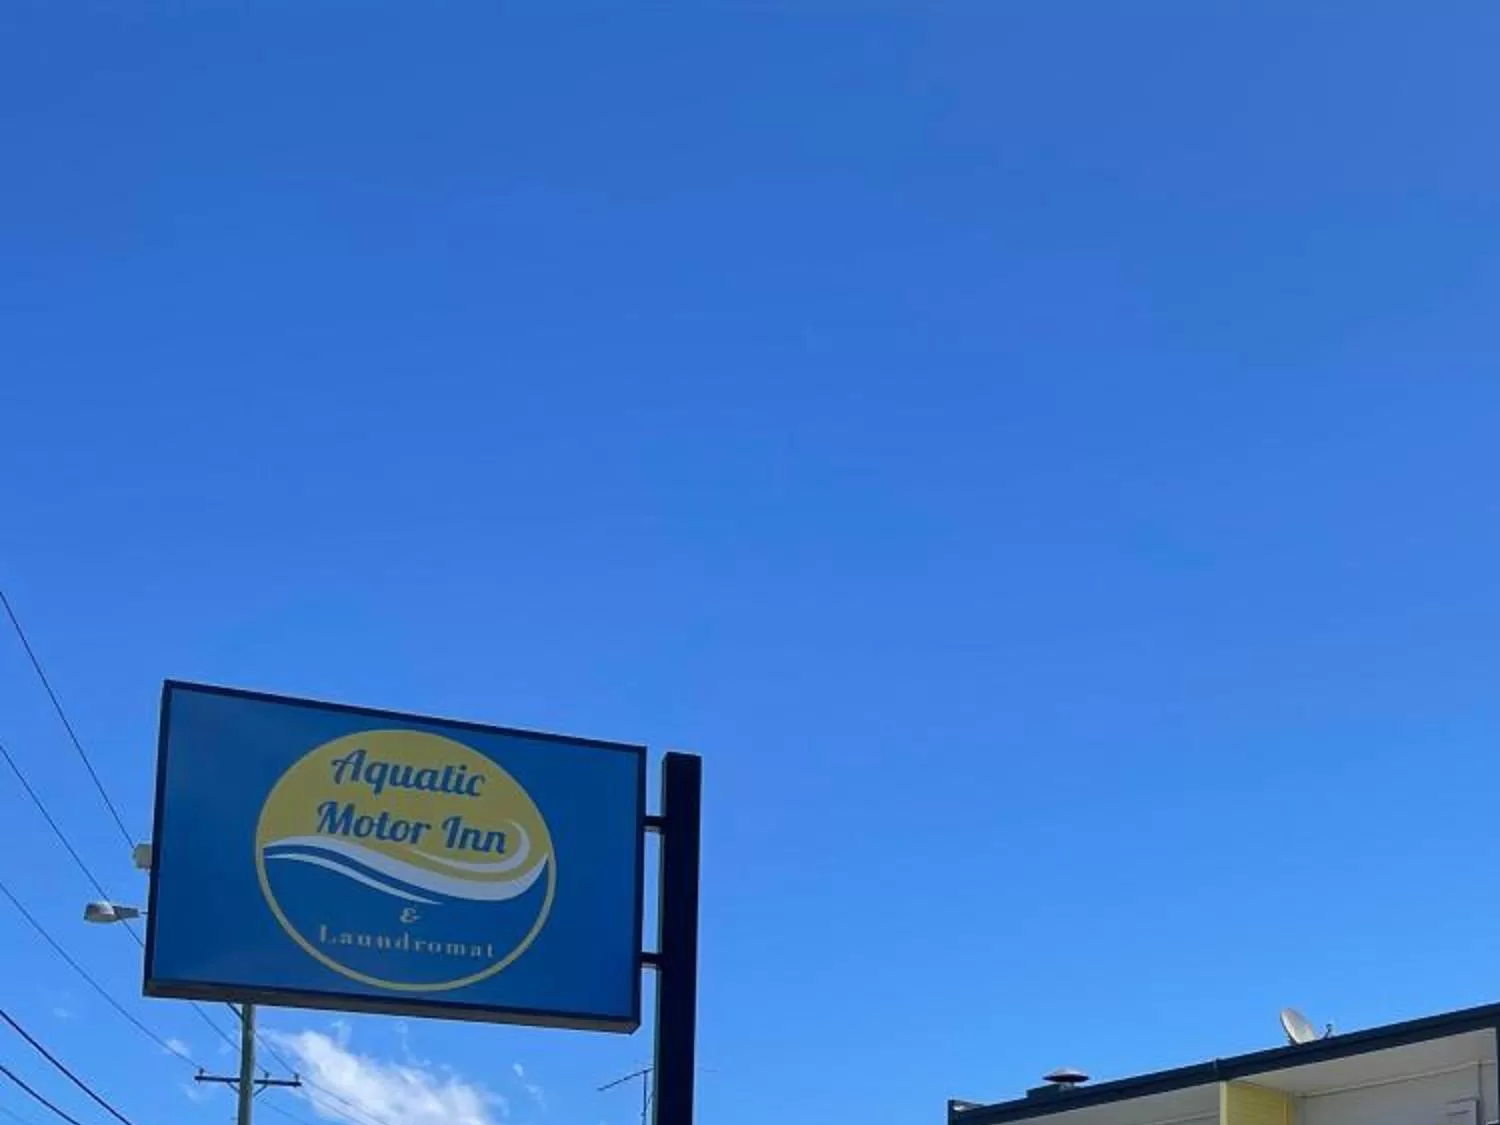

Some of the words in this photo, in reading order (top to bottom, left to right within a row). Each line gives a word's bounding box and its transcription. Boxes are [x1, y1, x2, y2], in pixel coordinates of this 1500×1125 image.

[331, 749, 486, 796] Aquatic
[316, 799, 432, 844] Motor
[442, 815, 508, 855] Inn
[400, 906, 422, 924] &
[319, 923, 495, 958] Laundromat
